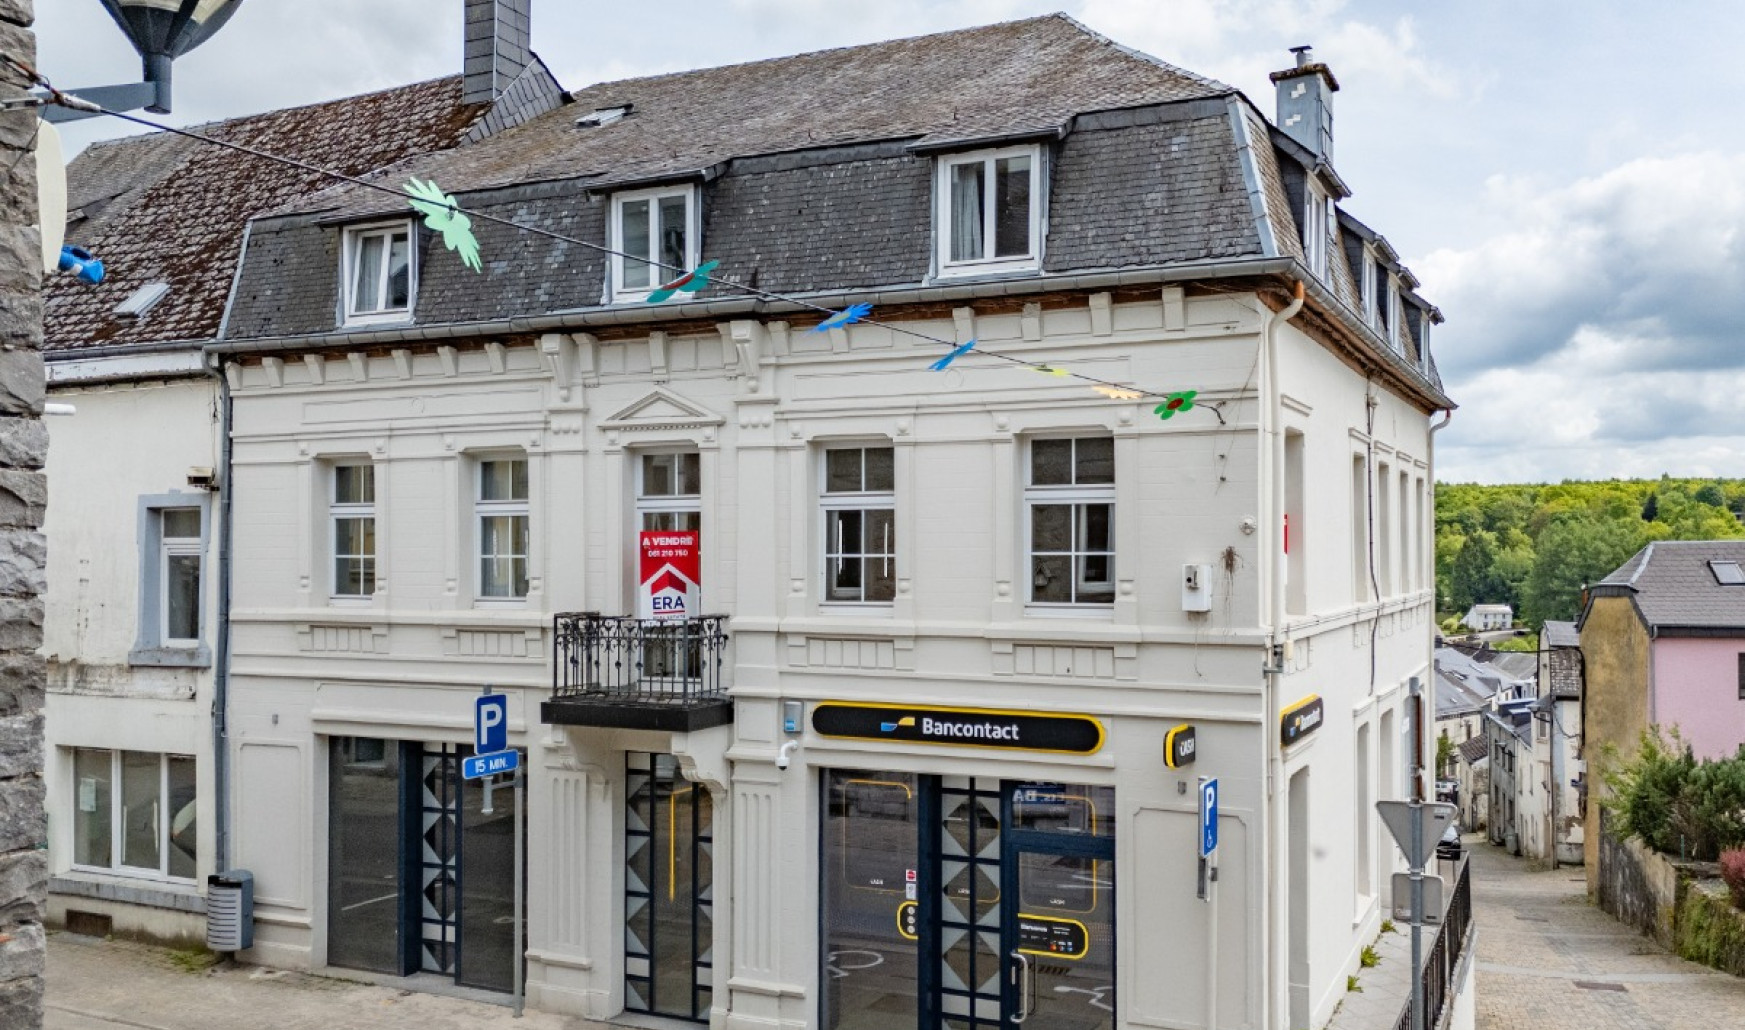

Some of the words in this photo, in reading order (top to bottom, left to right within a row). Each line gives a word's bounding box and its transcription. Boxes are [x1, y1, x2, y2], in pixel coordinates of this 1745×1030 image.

[642, 537, 651, 546] A
[652, 535, 693, 546] VENDRE
[652, 596, 685, 610] ERA
[481, 703, 502, 745] P
[922, 717, 1019, 740] Bancontact
[475, 759, 486, 773] 15
[1205, 786, 1215, 827] P
